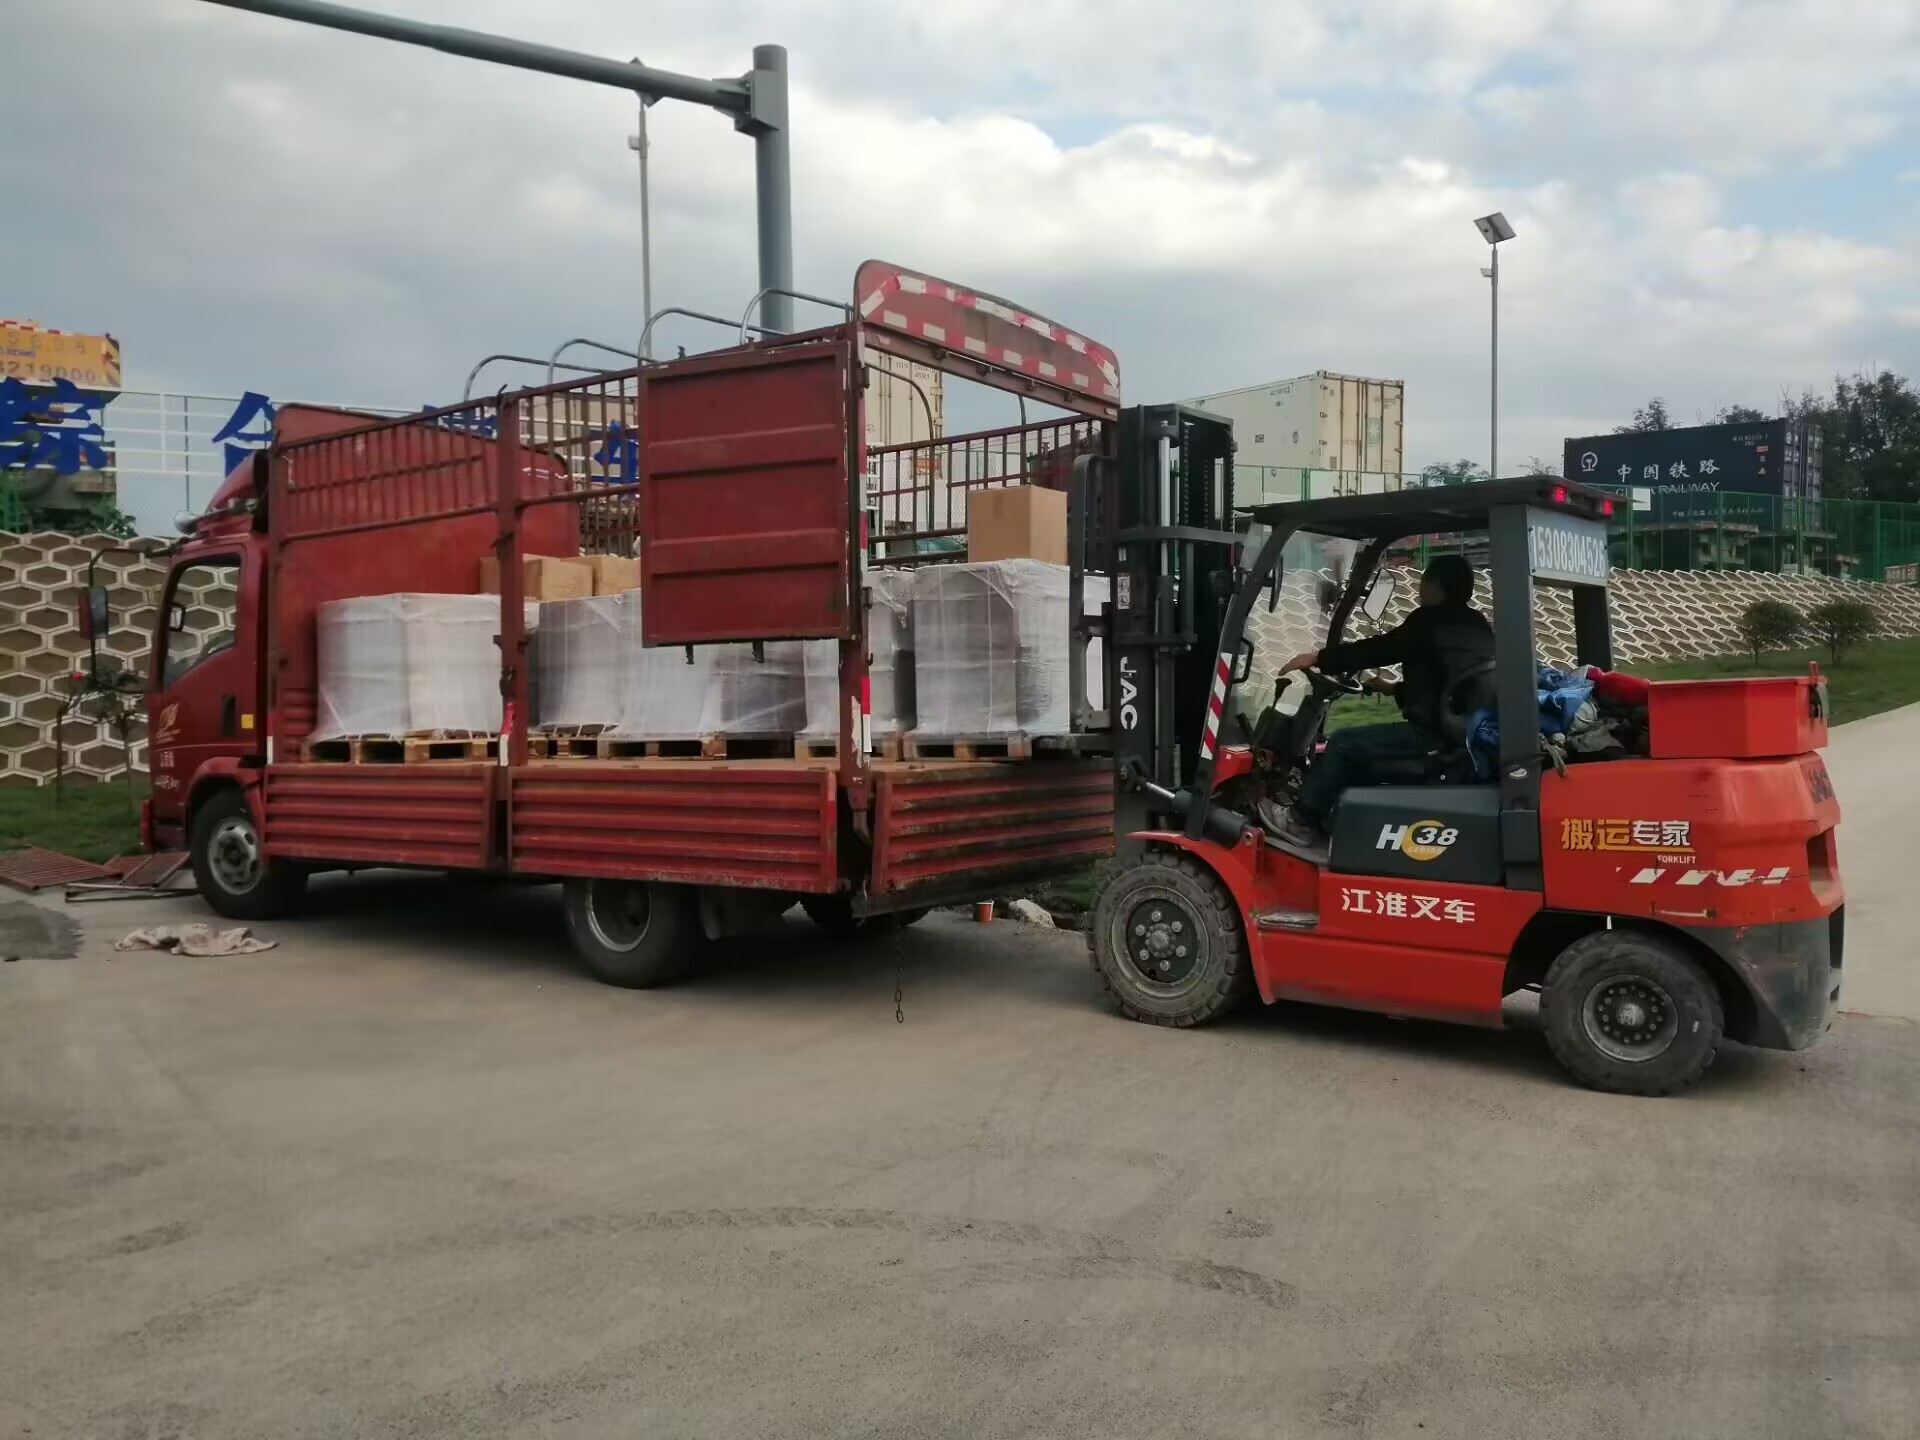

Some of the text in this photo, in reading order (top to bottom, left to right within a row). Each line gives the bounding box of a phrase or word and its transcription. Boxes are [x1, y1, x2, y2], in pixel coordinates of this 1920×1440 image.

[1617, 459, 1720, 483] 中国铁路
[1658, 481, 1720, 495] RAILWAY
[1529, 525, 1607, 578] 15308304526
[1120, 656, 1138, 730] JAC
[1560, 818, 1692, 850] 搬运专家
[1657, 855, 1696, 864] FORKLIFT
[1341, 887, 1476, 923] 江淮叉车
